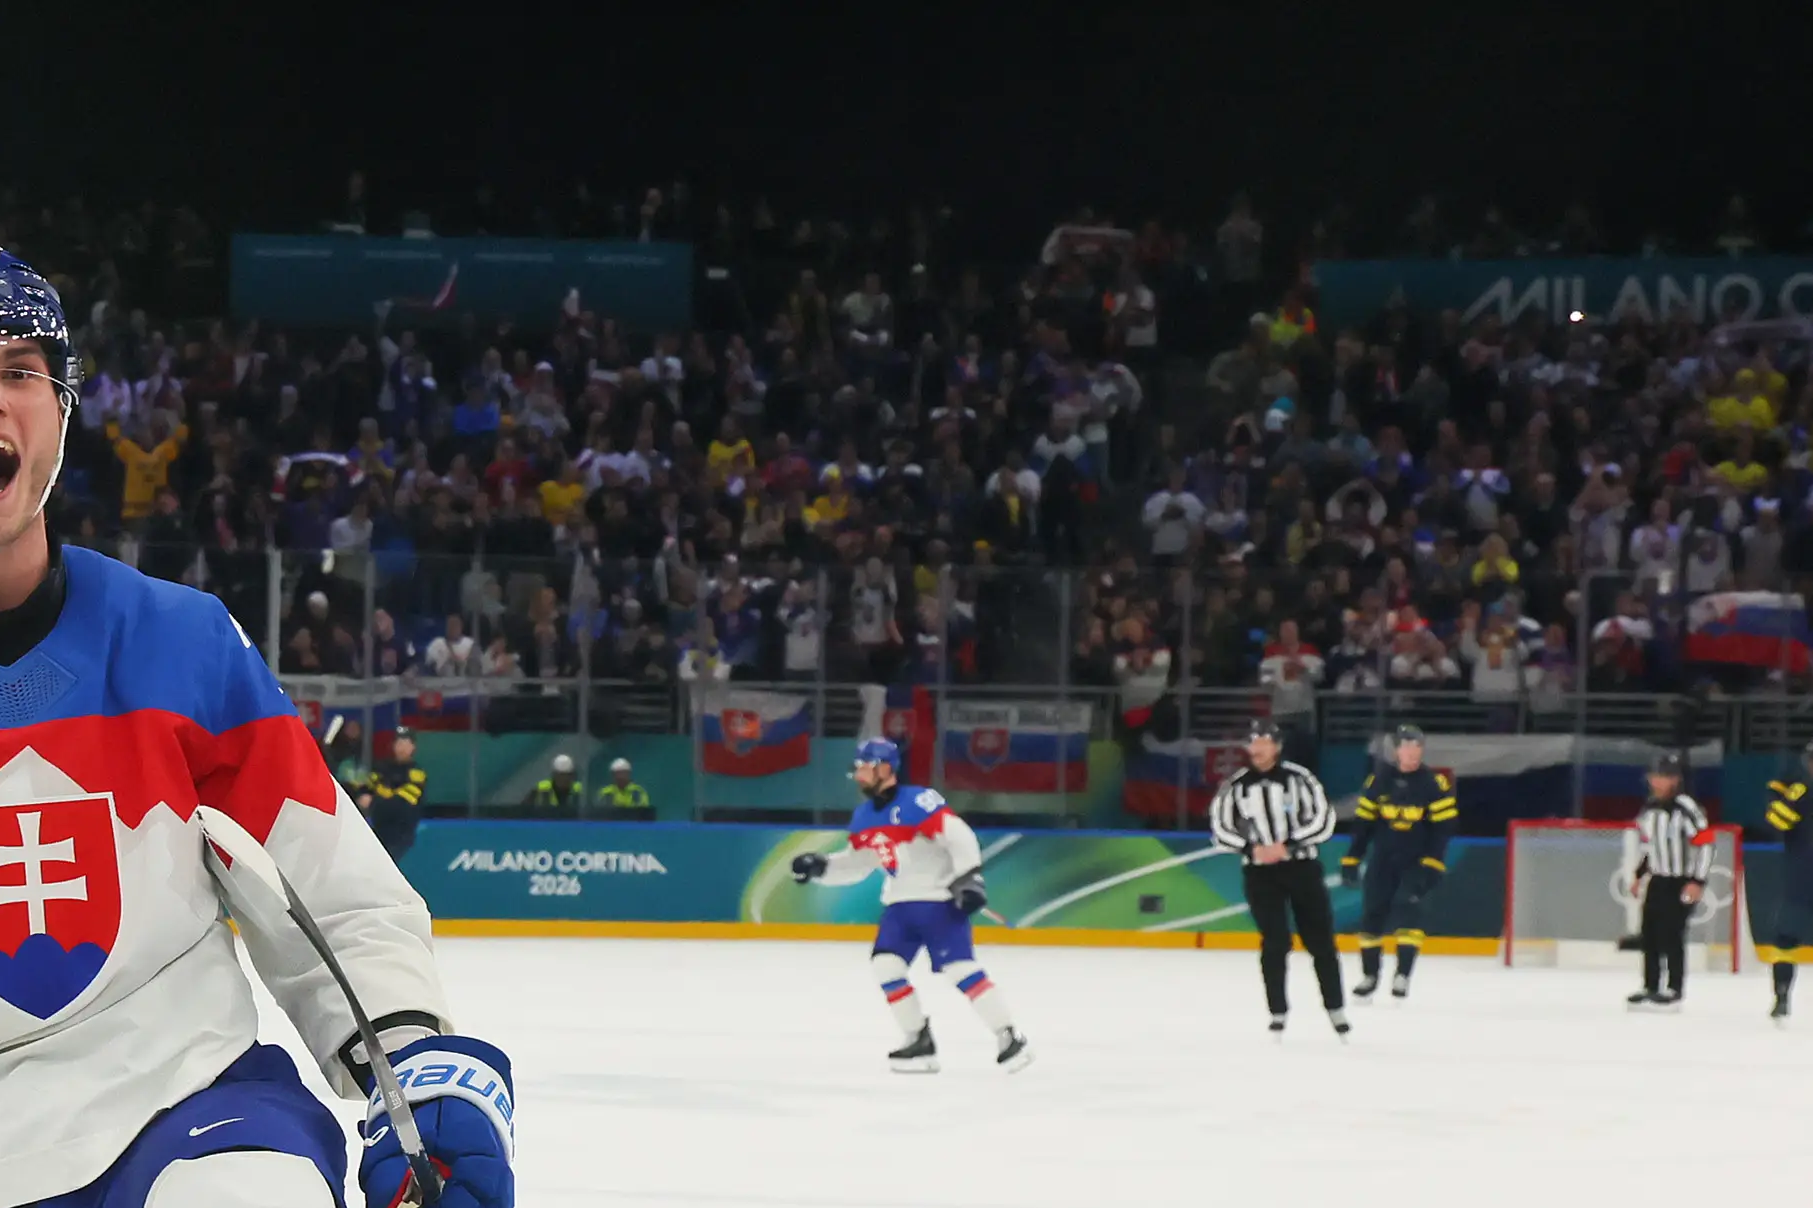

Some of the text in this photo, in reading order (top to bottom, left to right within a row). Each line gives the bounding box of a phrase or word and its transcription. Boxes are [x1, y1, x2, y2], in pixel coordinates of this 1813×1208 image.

[1461, 273, 1763, 325] MILANO
[447, 849, 668, 874] MILANO CORTINA
[528, 873, 582, 896] 2026
